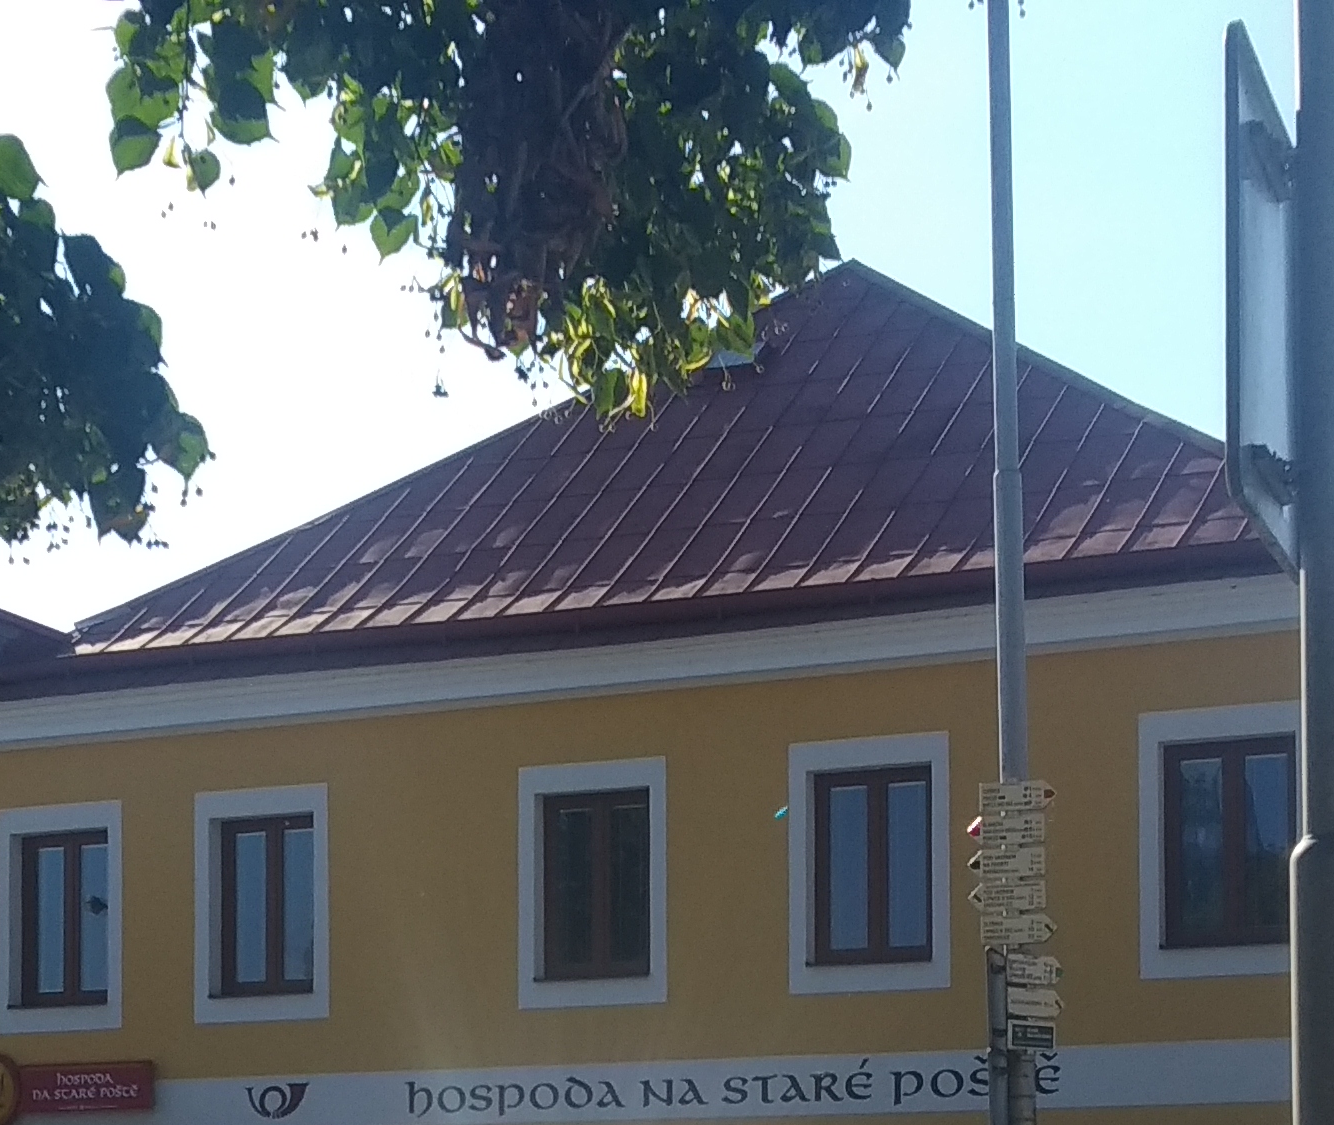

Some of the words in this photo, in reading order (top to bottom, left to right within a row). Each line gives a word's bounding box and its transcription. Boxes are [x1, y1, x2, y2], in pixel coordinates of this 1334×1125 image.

[32, 1090, 50, 1101] NA
[54, 1086, 97, 1100] STARÉ
[100, 1084, 139, 1099] POŠTĚ
[639, 1078, 709, 1108] NA
[721, 1057, 874, 1105] STARÉ
[889, 1051, 1062, 1107] POŠĚ
